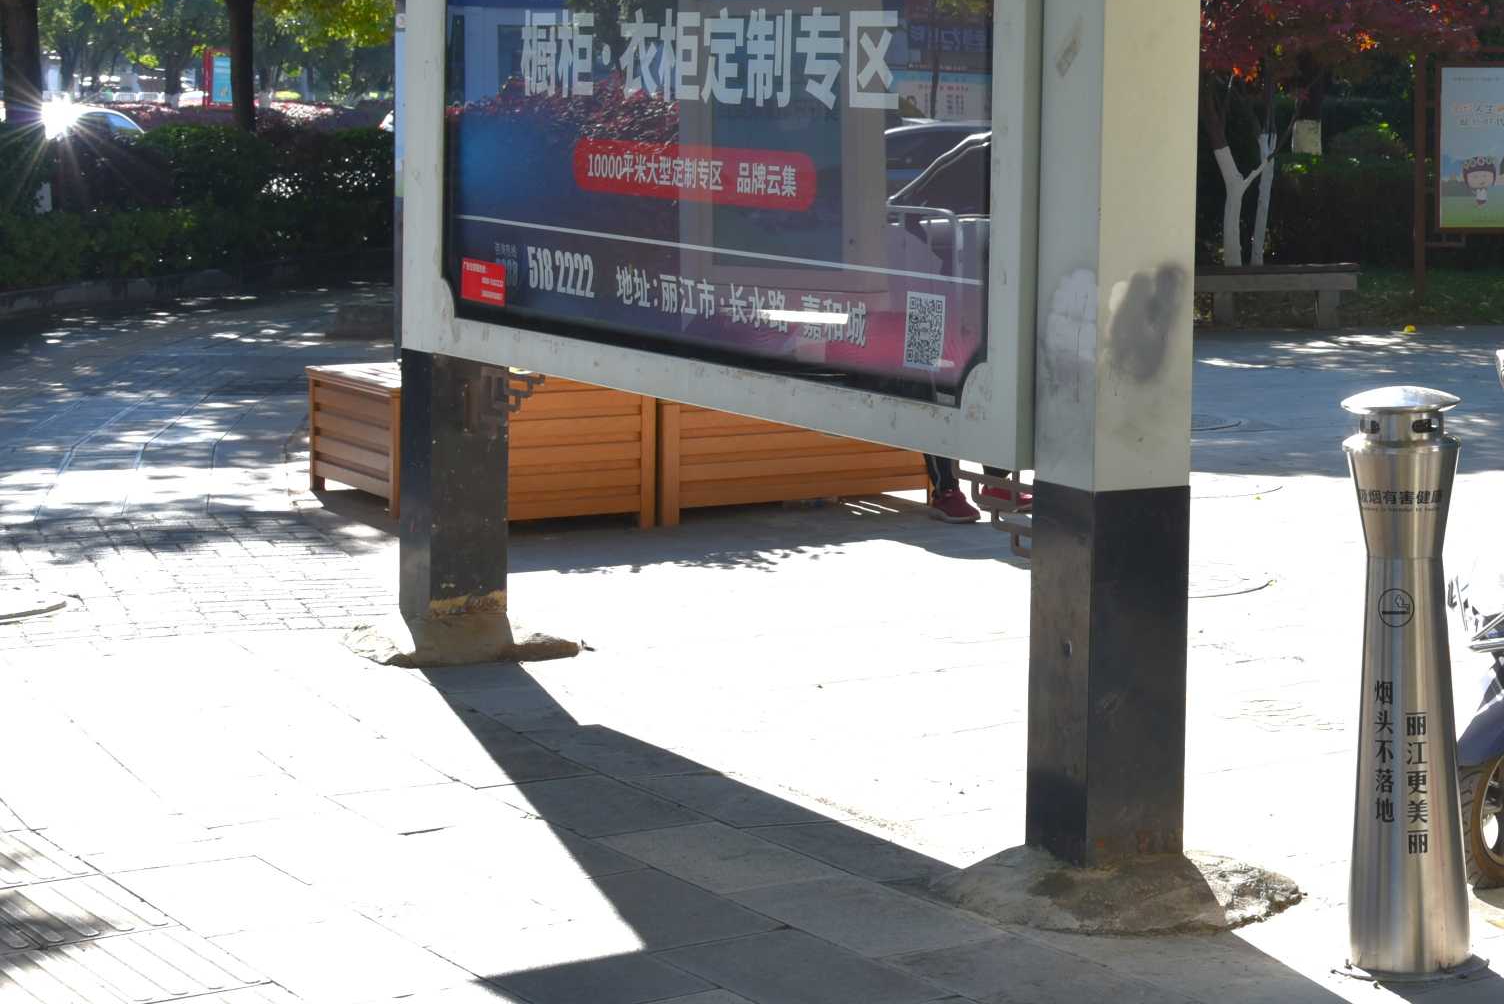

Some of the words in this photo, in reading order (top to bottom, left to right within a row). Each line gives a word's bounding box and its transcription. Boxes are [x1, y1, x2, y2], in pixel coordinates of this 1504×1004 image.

[586, 153, 725, 193] 10000平米大型定制专区
[736, 162, 798, 198] 品牌云集
[527, 245, 554, 291] 518
[554, 250, 595, 299] 2222
[1374, 679, 1396, 823] 烟头不落地
[1405, 711, 1429, 855] 丽江更美丽
